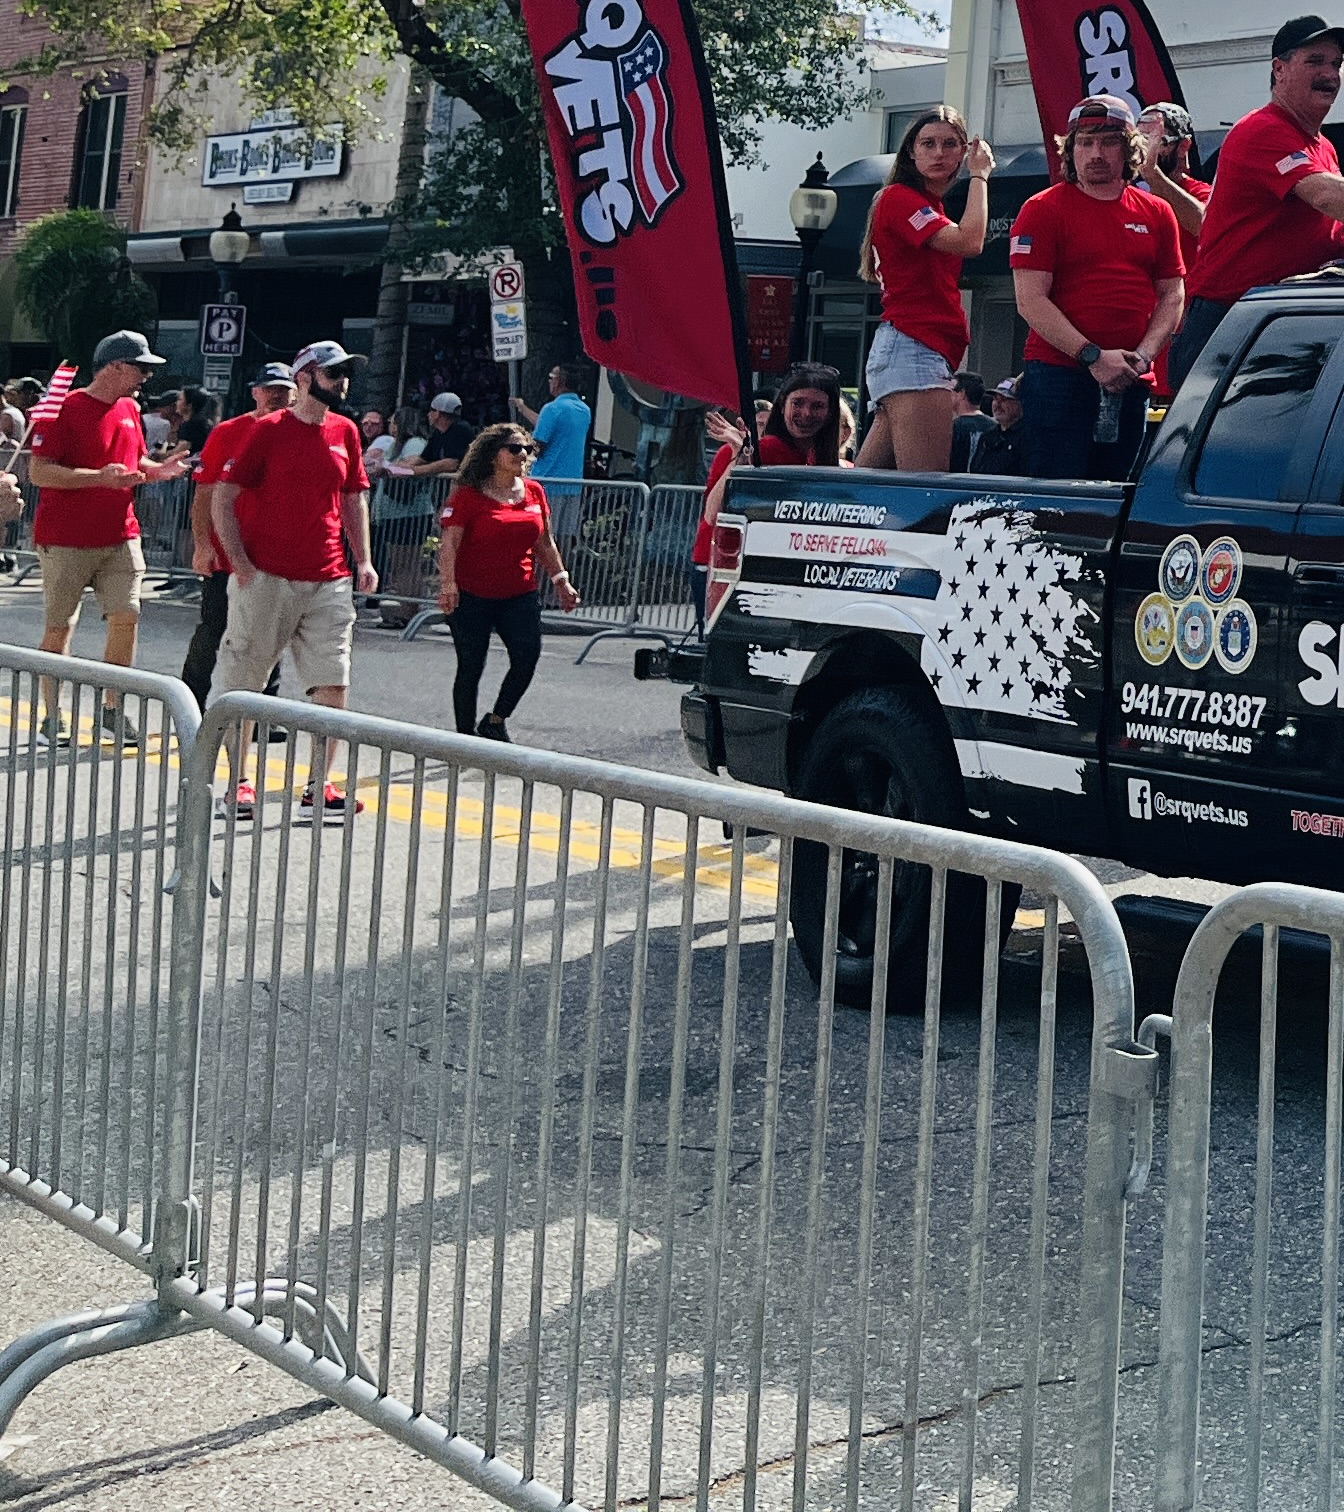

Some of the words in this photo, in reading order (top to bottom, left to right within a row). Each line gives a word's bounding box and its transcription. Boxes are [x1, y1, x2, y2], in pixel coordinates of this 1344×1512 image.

[544, 39, 635, 243] VETS
[212, 308, 238, 318] PAY
[205, 343, 239, 353] HERE
[774, 500, 803, 520] VETS
[801, 501, 887, 526] VOLUNTEERING
[789, 533, 803, 551] TO
[803, 534, 840, 554] SERVE
[840, 536, 888, 557] FELLOW
[804, 565, 840, 586] LOCAL
[838, 567, 901, 591] VETERANS
[1121, 681, 1267, 729] 941.777.8387
[1126, 722, 1253, 754] www.srqvets.us
[1154, 791, 1249, 827] @srqvets.us
